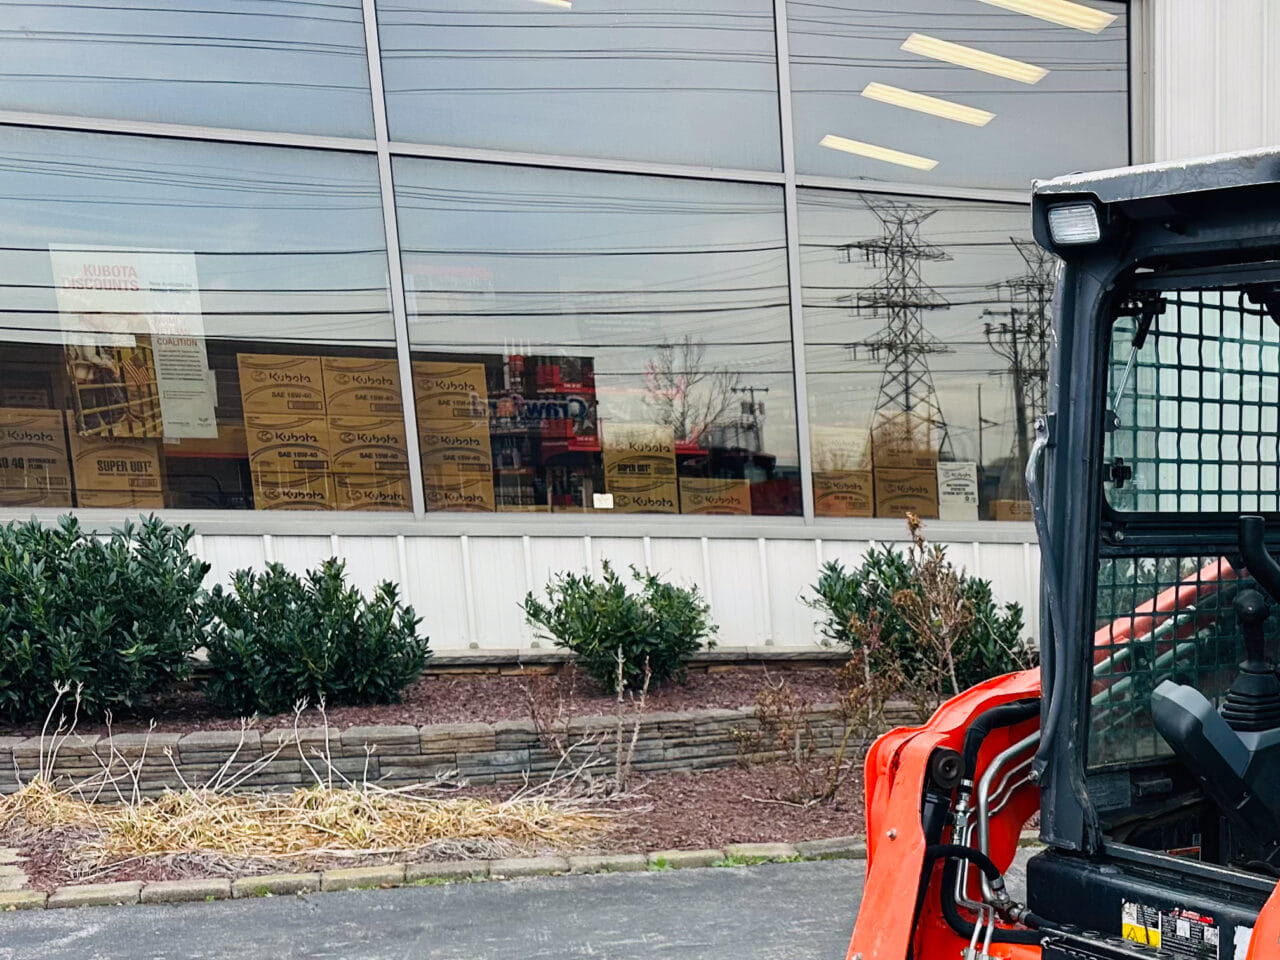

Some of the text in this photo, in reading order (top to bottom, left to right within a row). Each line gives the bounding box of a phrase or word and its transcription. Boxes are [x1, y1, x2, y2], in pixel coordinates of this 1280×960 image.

[83, 264, 138, 279] KUBOTA
[62, 277, 140, 291] DISCOUNTS
[157, 337, 198, 347] COALITION
[269, 372, 312, 383] Kubota
[352, 375, 394, 386] Kubota
[436, 380, 476, 391] Kubota
[8, 431, 54, 442] Kubota
[276, 432, 319, 443] Kubota
[358, 433, 399, 444] Kubota
[440, 436, 480, 446] Kubota
[629, 441, 670, 452] Kubota
[97, 460, 128, 472] SUPER
[283, 490, 325, 500] Kubota
[364, 490, 405, 501] Kubota
[444, 493, 484, 503] Kubota
[705, 495, 741, 505] Kubota
[632, 496, 674, 507] Kubota
